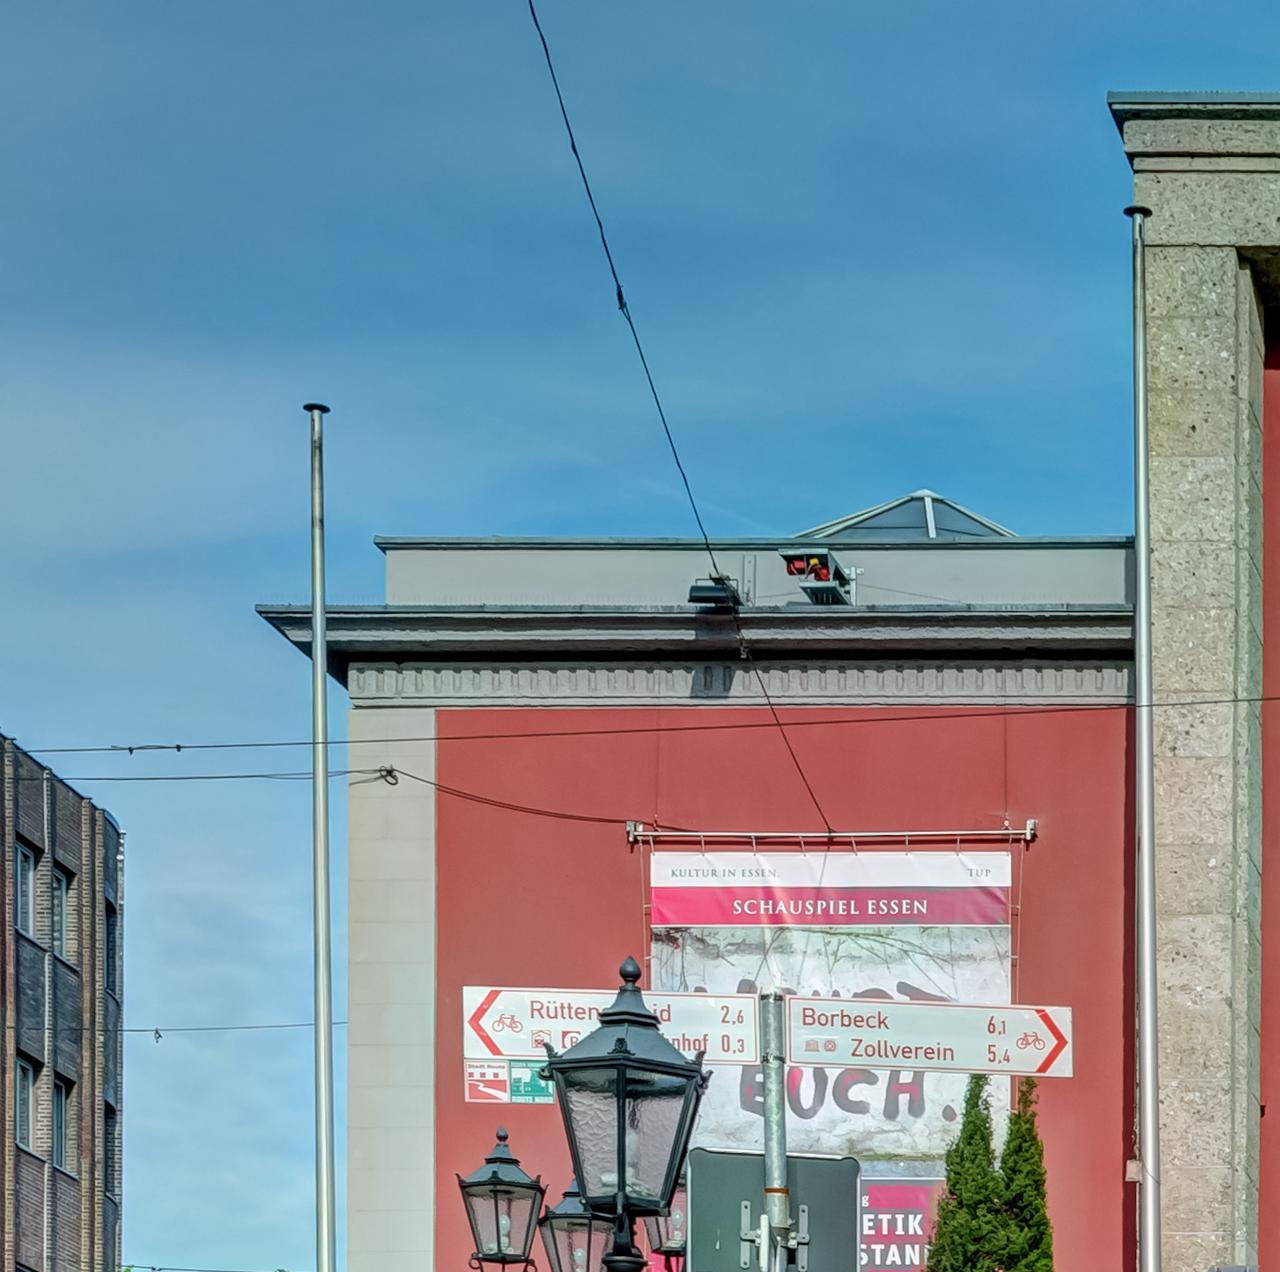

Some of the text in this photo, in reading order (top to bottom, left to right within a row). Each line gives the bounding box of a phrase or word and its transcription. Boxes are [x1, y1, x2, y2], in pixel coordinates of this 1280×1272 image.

[671, 868, 718, 878] KULTUR
[722, 868, 736, 878] IN
[733, 899, 928, 916] SCHAUSPIEL ESSEN
[530, 1000, 744, 1025] Rüttenid 2,6
[802, 1008, 1007, 1035] Borbeck 6,1
[721, 1035, 745, 1054] 0,3
[851, 1038, 1011, 1065] Zollverein 5,4
